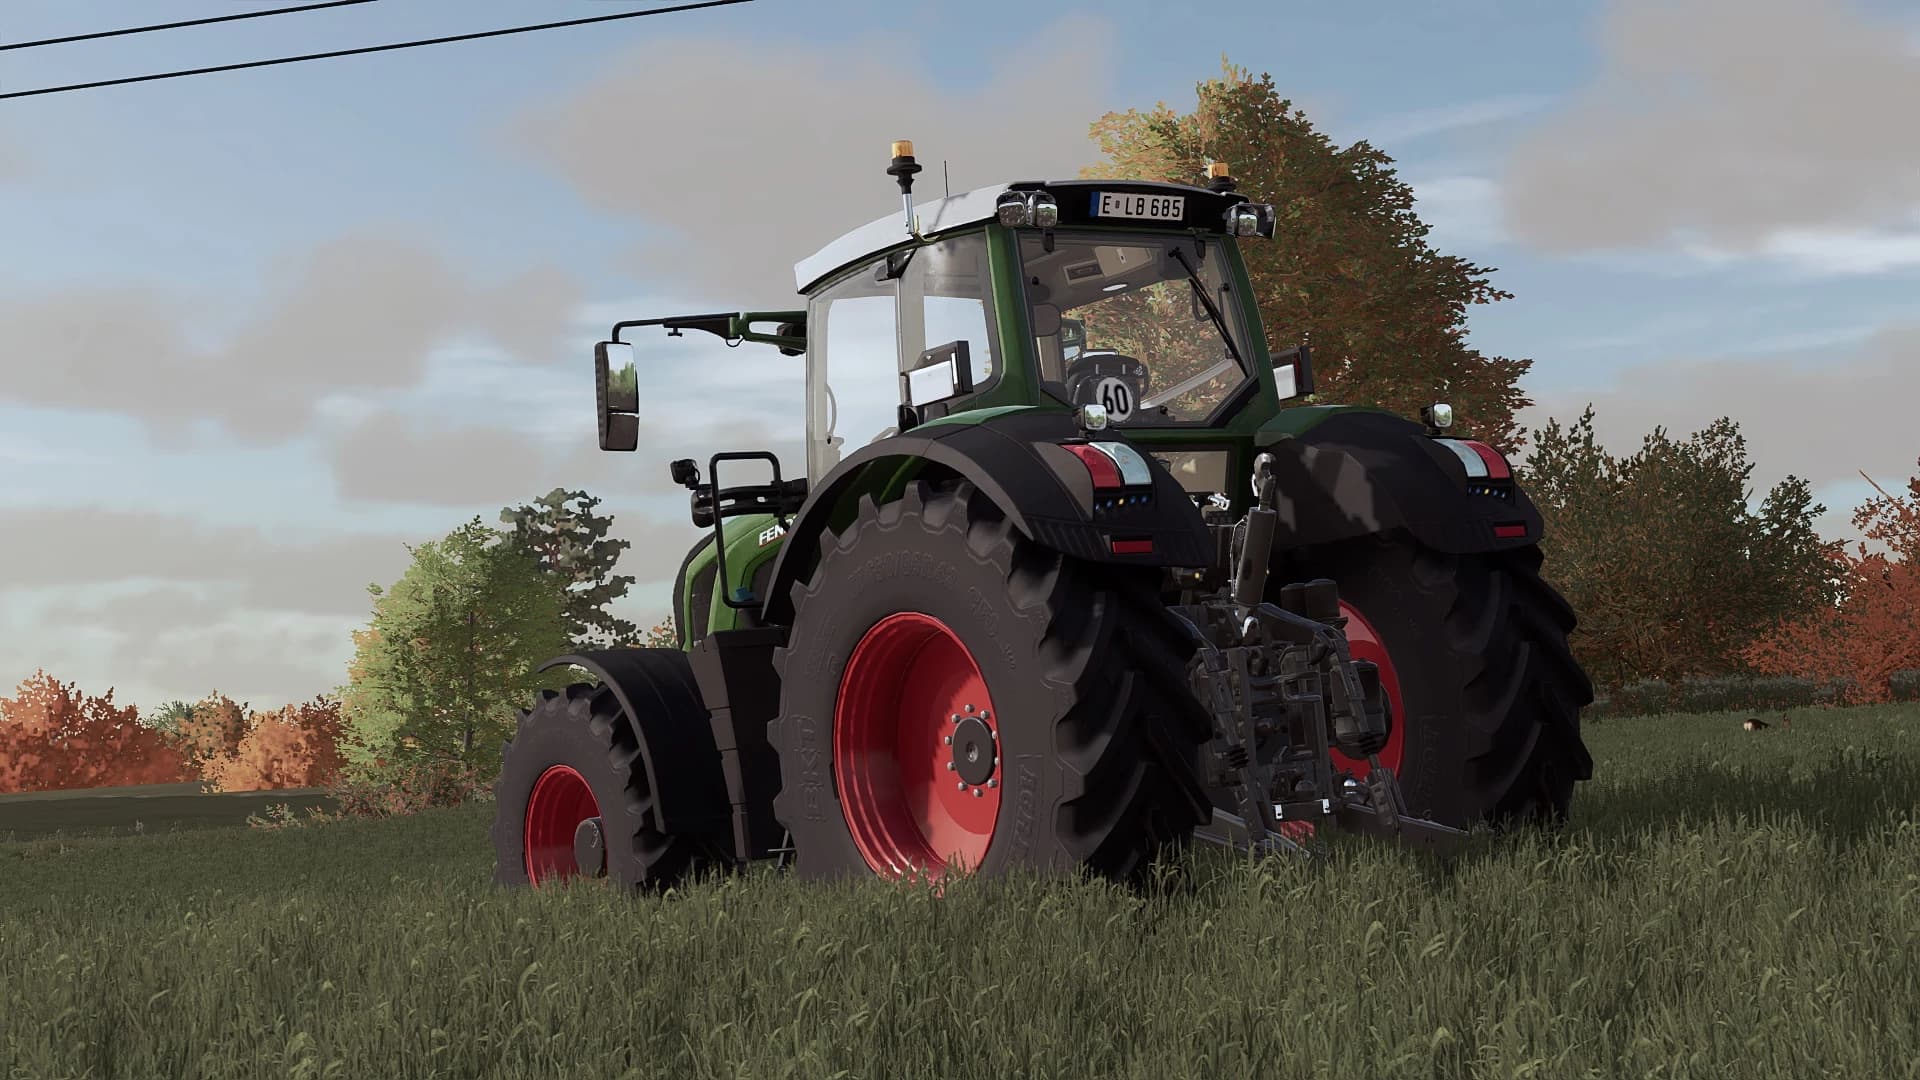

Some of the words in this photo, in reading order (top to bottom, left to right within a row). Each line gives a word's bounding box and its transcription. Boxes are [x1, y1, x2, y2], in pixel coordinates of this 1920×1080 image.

[1102, 195, 1112, 214] E
[1125, 196, 1145, 216] LB
[1150, 198, 1181, 218] 685
[1103, 383, 1129, 415] 60
